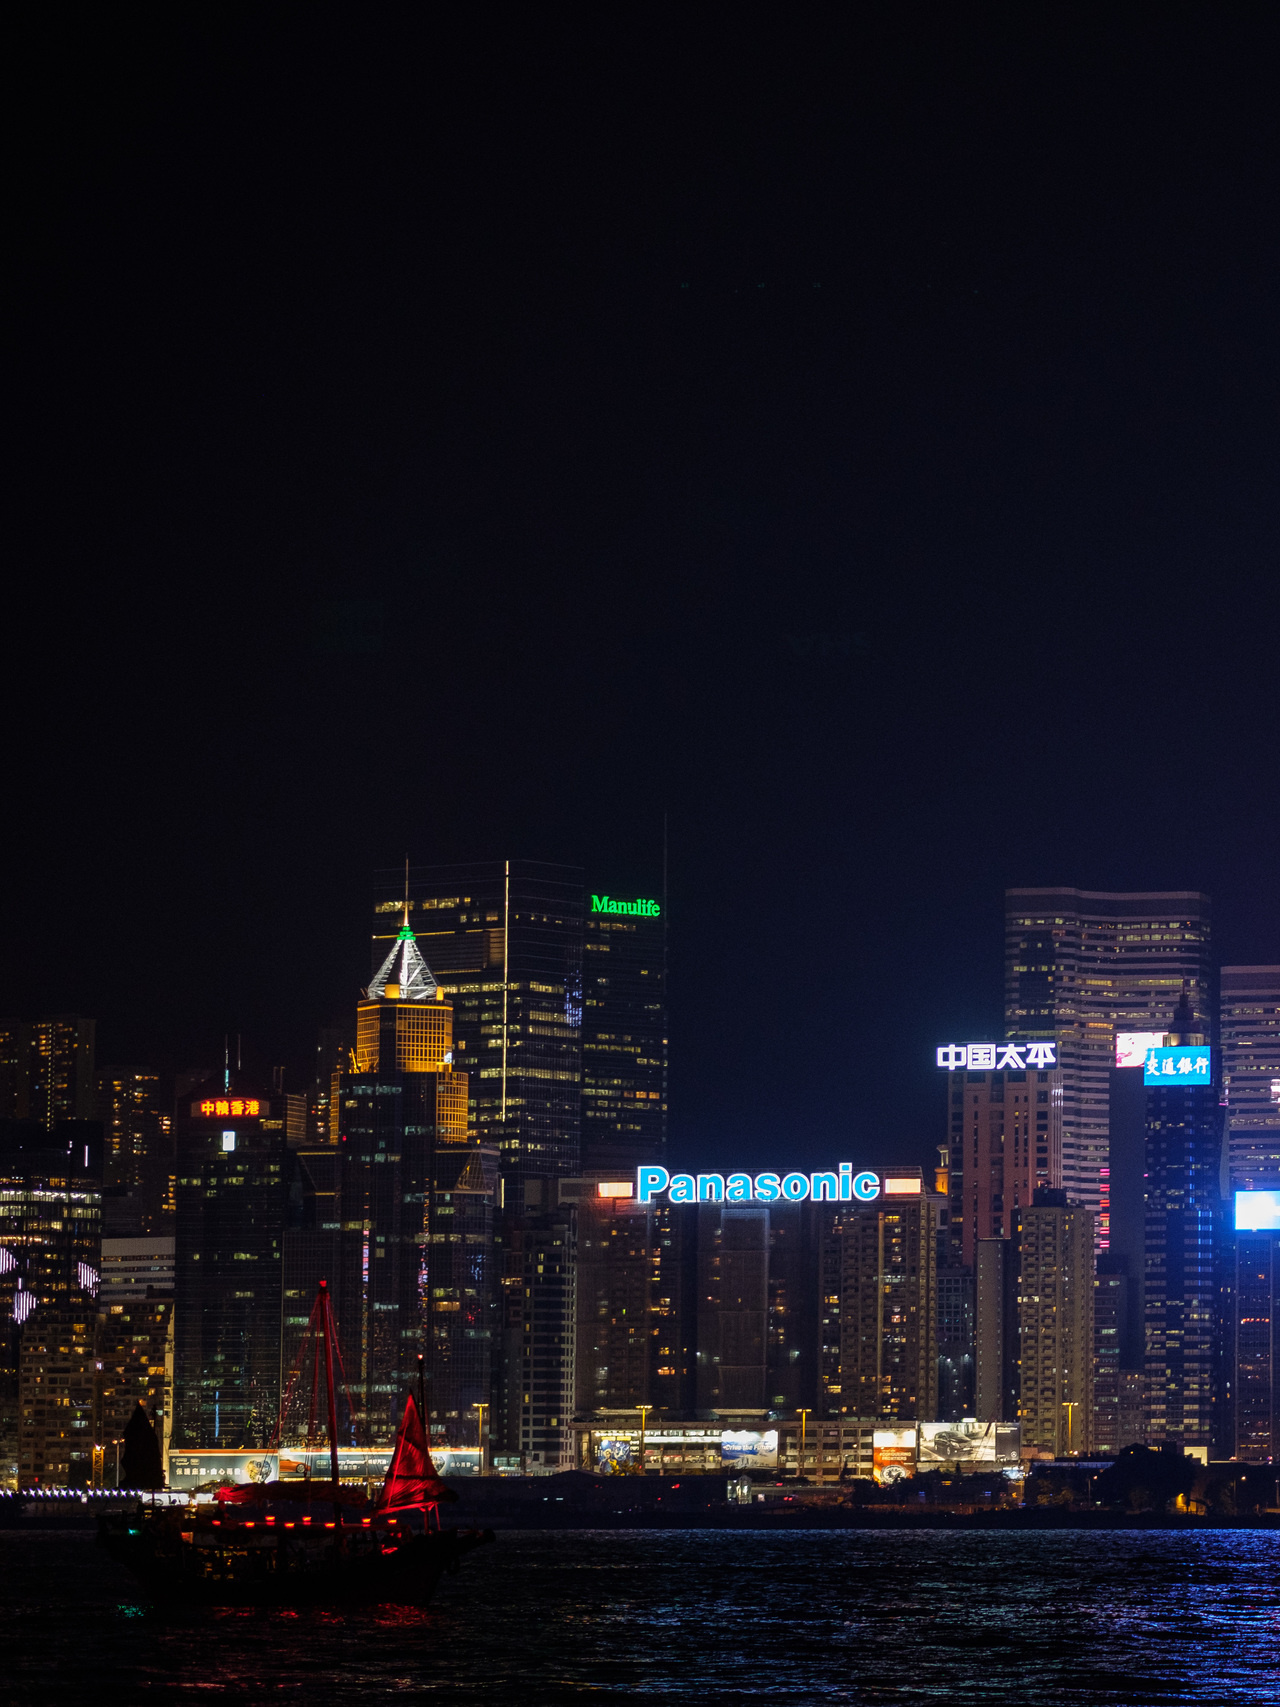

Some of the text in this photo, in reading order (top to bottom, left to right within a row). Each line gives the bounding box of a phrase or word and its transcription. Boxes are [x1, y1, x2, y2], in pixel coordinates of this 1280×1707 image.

[591, 894, 661, 917] Manulife
[936, 1043, 1056, 1071] 中国太平
[637, 1162, 881, 1204] Panasonic
